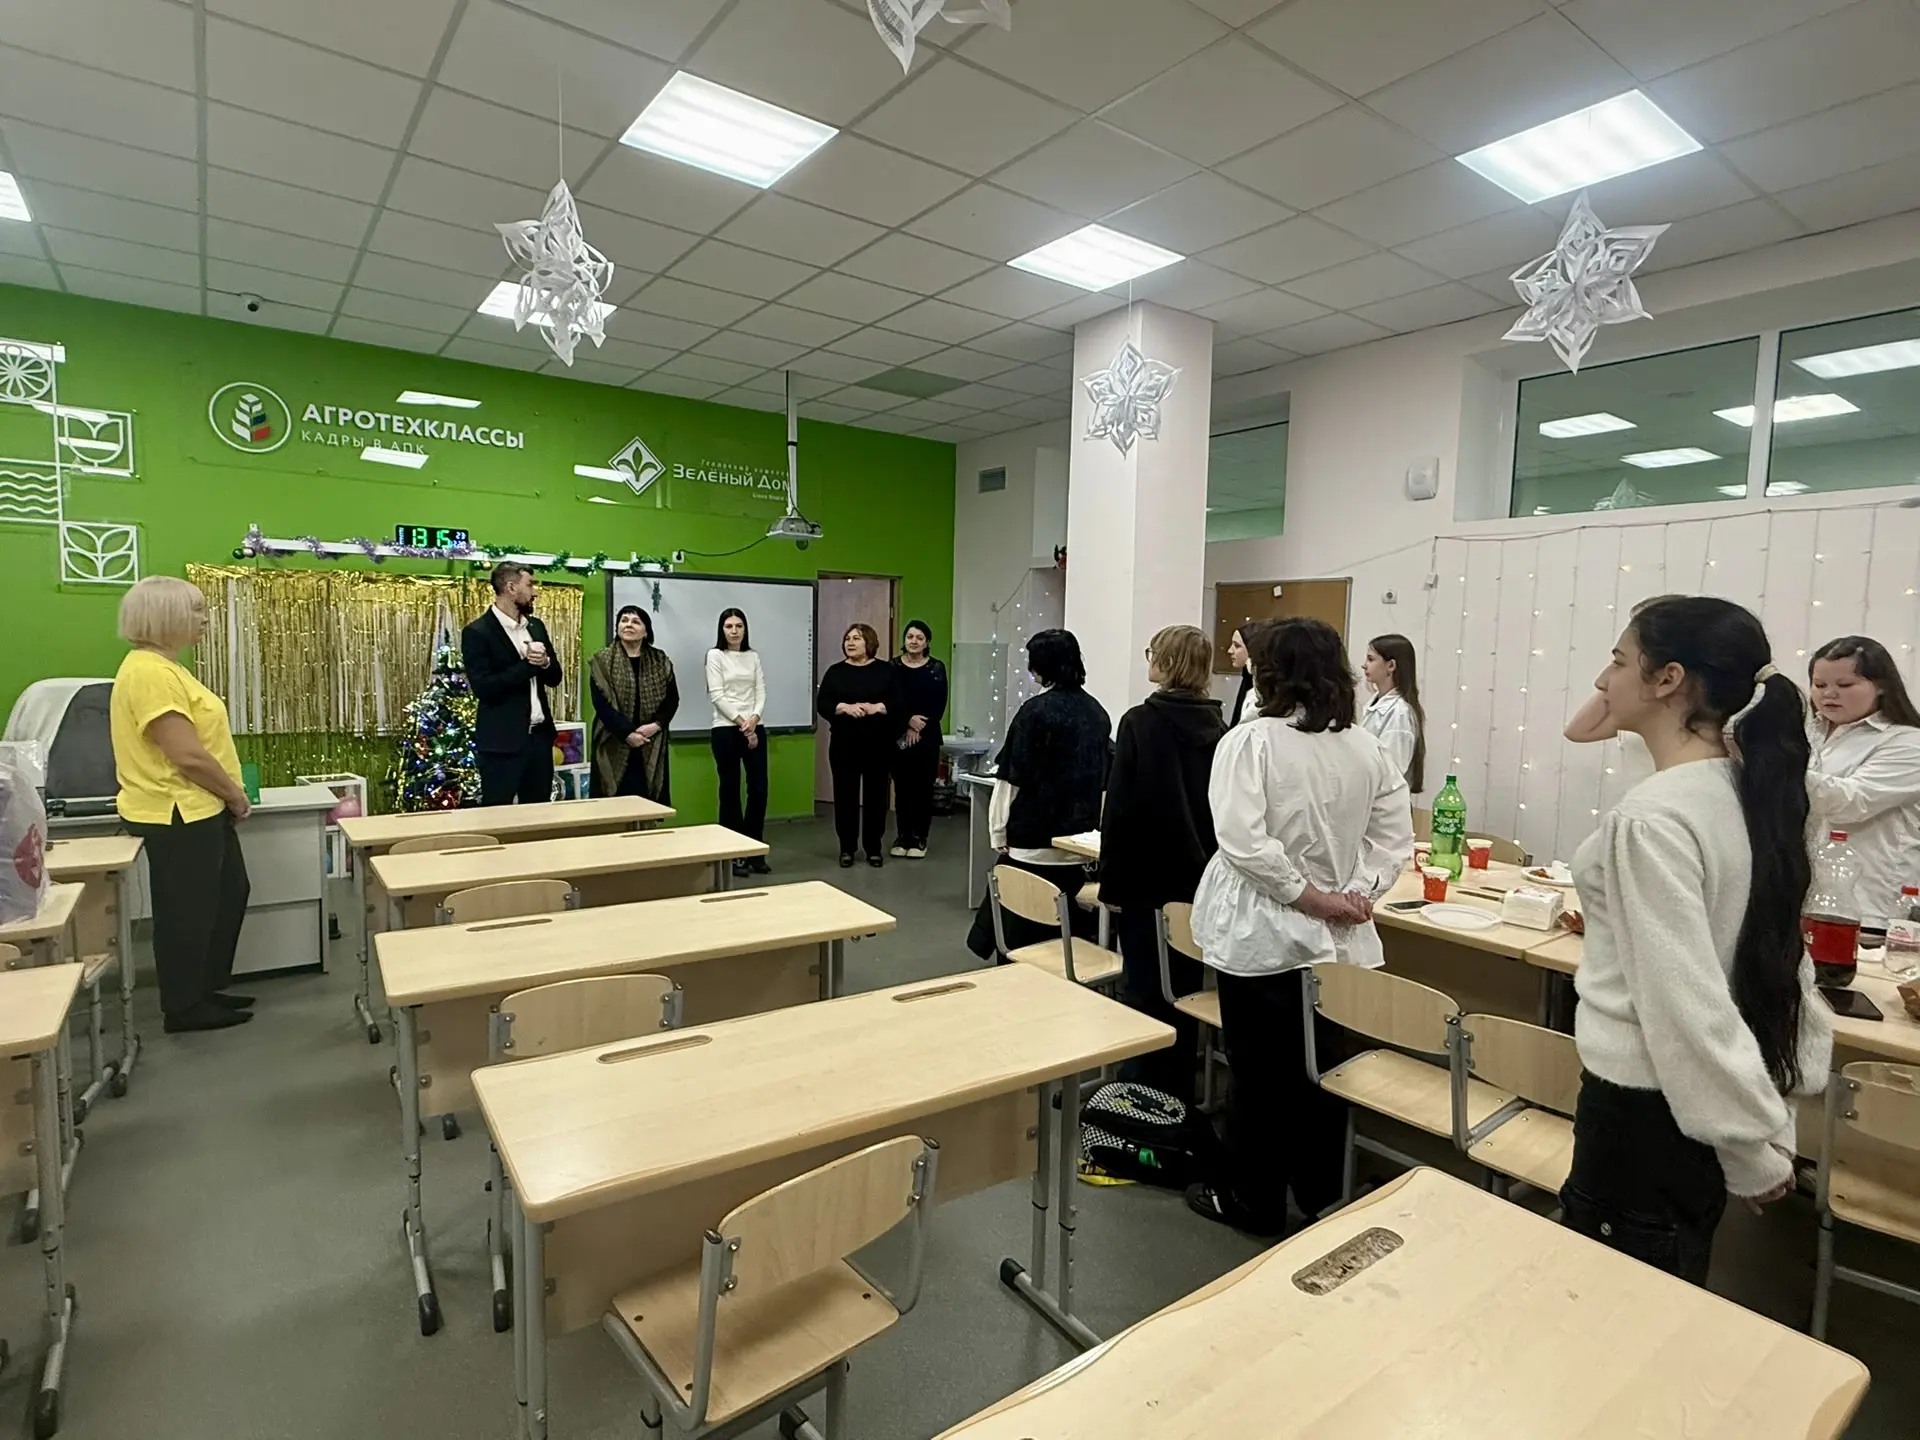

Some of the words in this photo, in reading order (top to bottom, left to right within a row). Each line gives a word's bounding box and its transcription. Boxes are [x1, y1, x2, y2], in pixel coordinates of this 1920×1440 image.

[301, 430, 364, 448] КАДРЫ
[373, 439, 382, 449] В
[391, 443, 425, 455] АПК
[302, 403, 524, 449] АГРОТЕХКЛАССЫ
